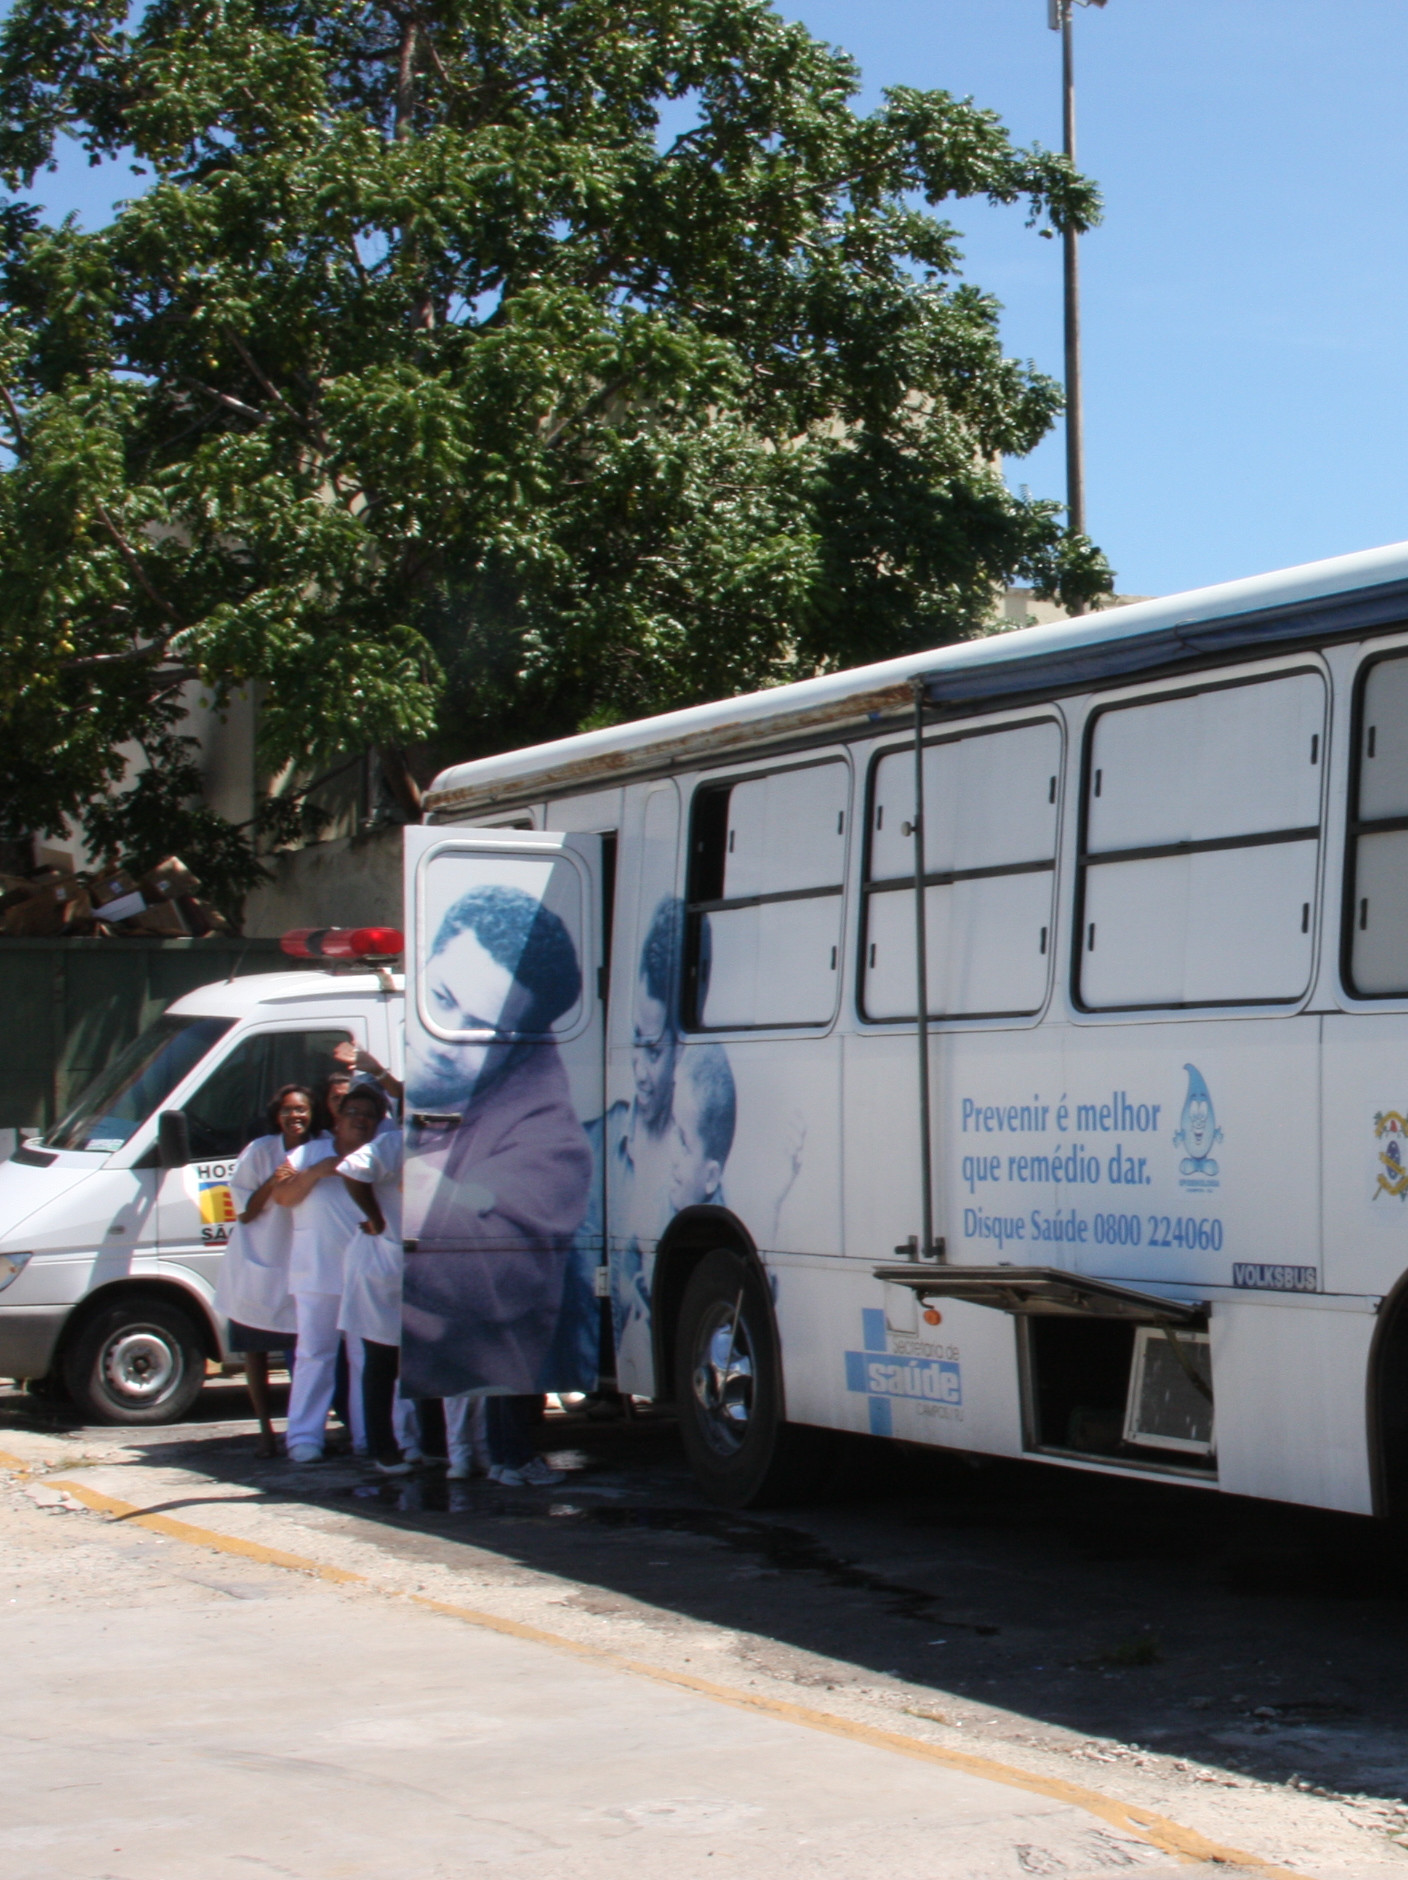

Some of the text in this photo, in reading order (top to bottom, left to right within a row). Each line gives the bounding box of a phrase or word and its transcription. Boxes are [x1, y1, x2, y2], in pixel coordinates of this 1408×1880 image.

[962, 1091, 1161, 1132] Prevenir é melhor
[962, 1143, 1152, 1194] que remédio dar.
[964, 1206, 1224, 1251] Disque Saúde 0800 224060
[1234, 1264, 1317, 1291] VOLKSBUS
[868, 1360, 960, 1403] saúde
